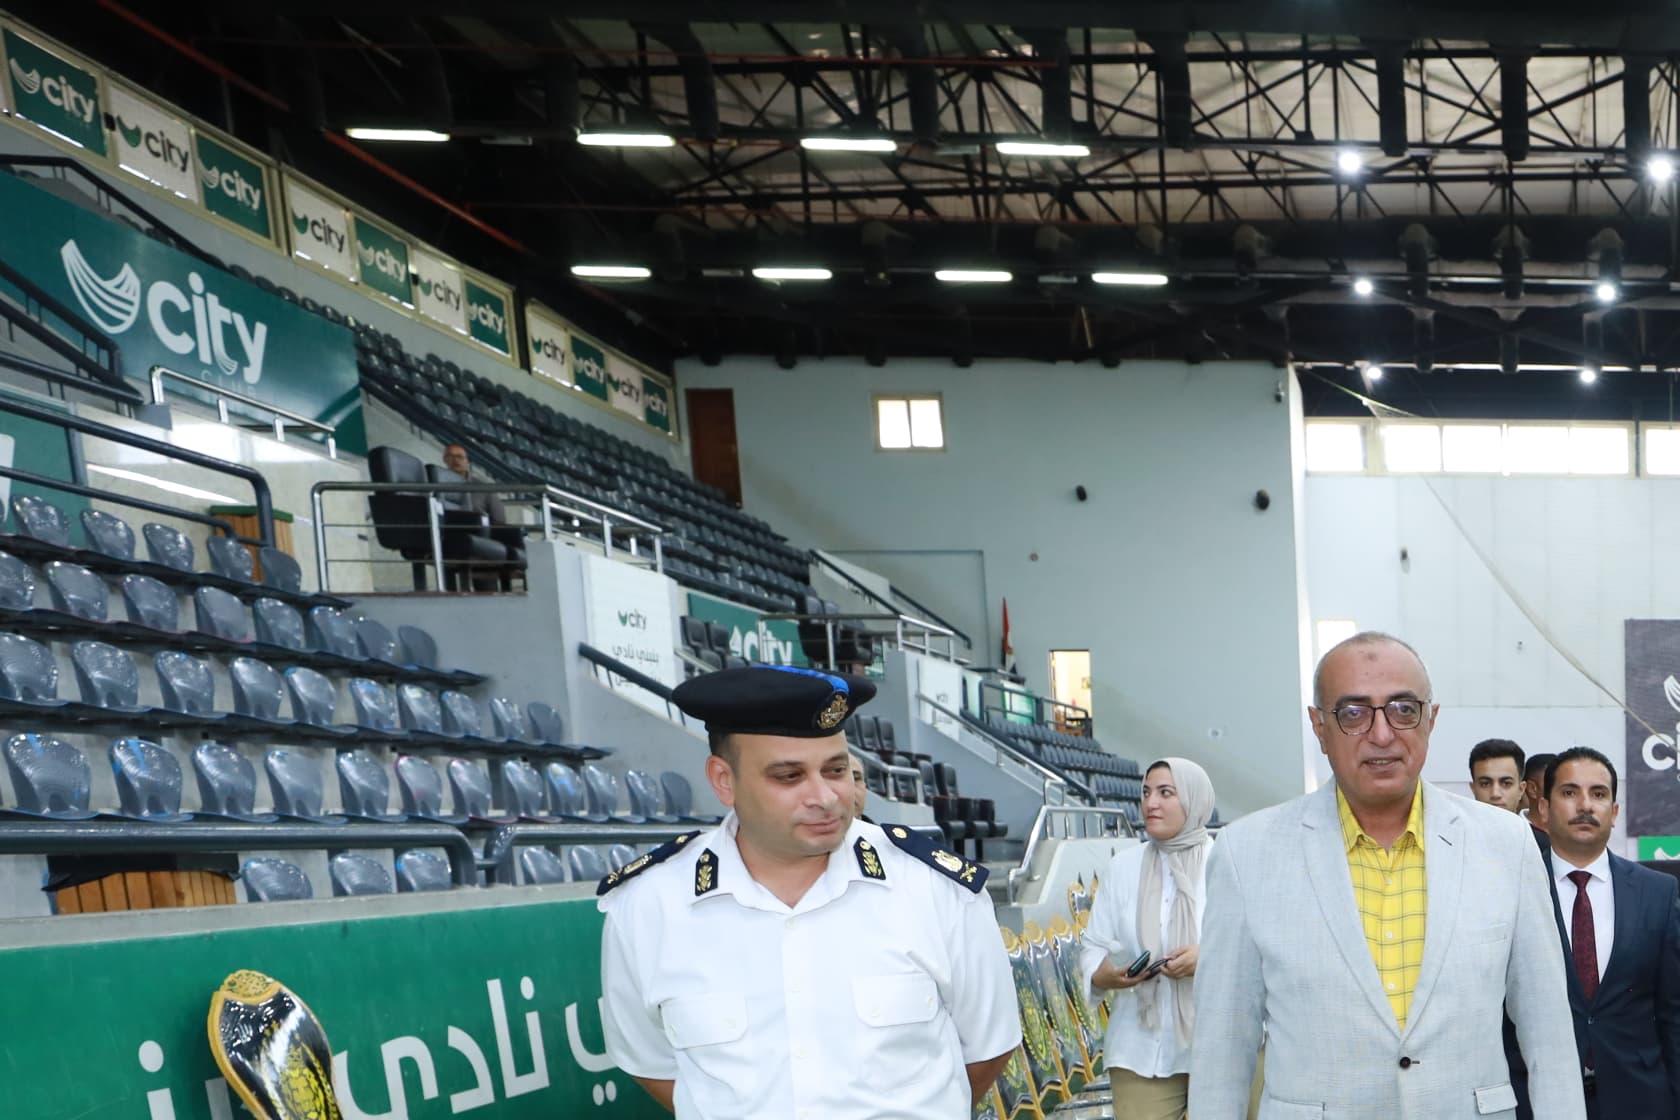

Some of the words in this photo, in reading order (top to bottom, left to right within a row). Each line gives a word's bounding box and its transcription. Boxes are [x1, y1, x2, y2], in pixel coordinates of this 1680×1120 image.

[42, 76, 95, 123] city
[144, 131, 189, 172] city
[220, 171, 261, 210] city
[310, 217, 345, 253] city
[375, 249, 406, 282] city
[433, 279, 461, 310] city
[147, 272, 267, 384] city
[478, 304, 504, 334] city
[543, 339, 565, 366] city
[583, 357, 604, 383] city
[620, 378, 639, 402] city
[629, 608, 646, 631] city
[743, 622, 792, 667] city
